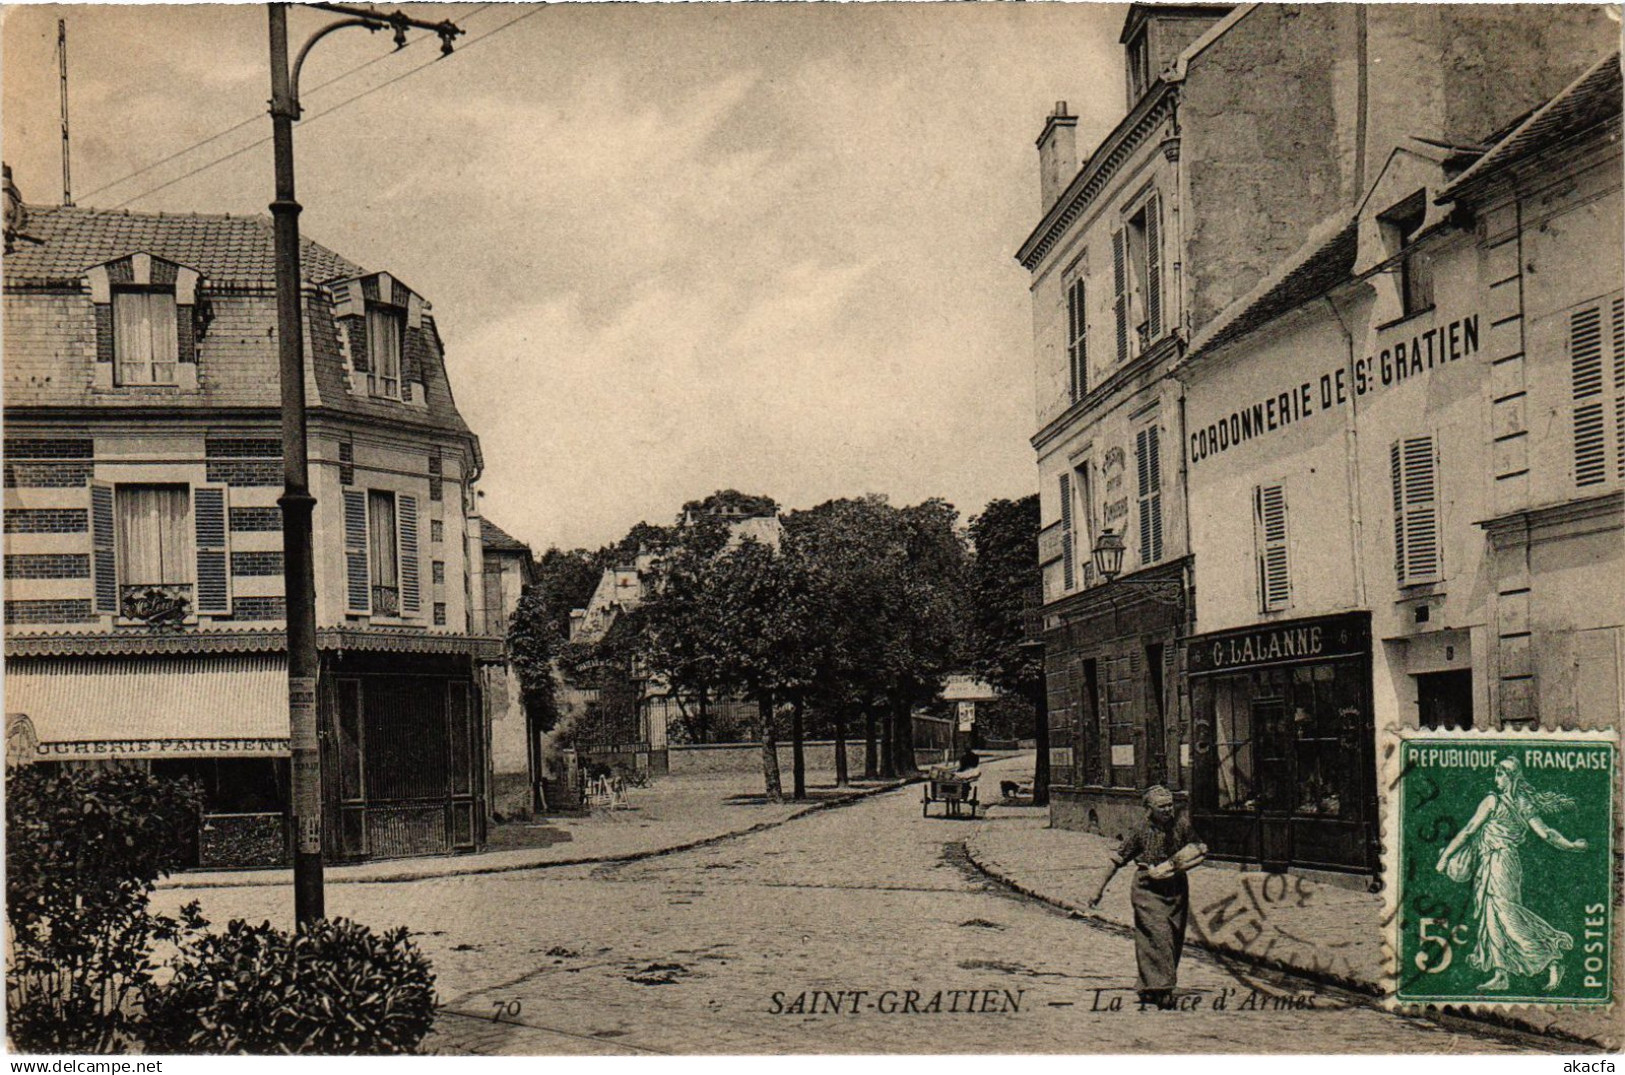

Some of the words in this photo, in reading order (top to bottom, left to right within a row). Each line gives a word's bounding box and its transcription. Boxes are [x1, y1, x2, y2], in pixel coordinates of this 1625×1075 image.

[1190, 382, 1312, 463] CORDONNERIE
[1320, 368, 1347, 410] DE
[1380, 314, 1479, 386] GRATIEN
[36, 741, 151, 755] UCHERIE
[159, 738, 291, 752] PARISIENN
[1408, 749, 1497, 770] REPUBLIQUE
[1525, 751, 1607, 771] FRANÇAISE
[1584, 903, 1605, 988] POSTES
